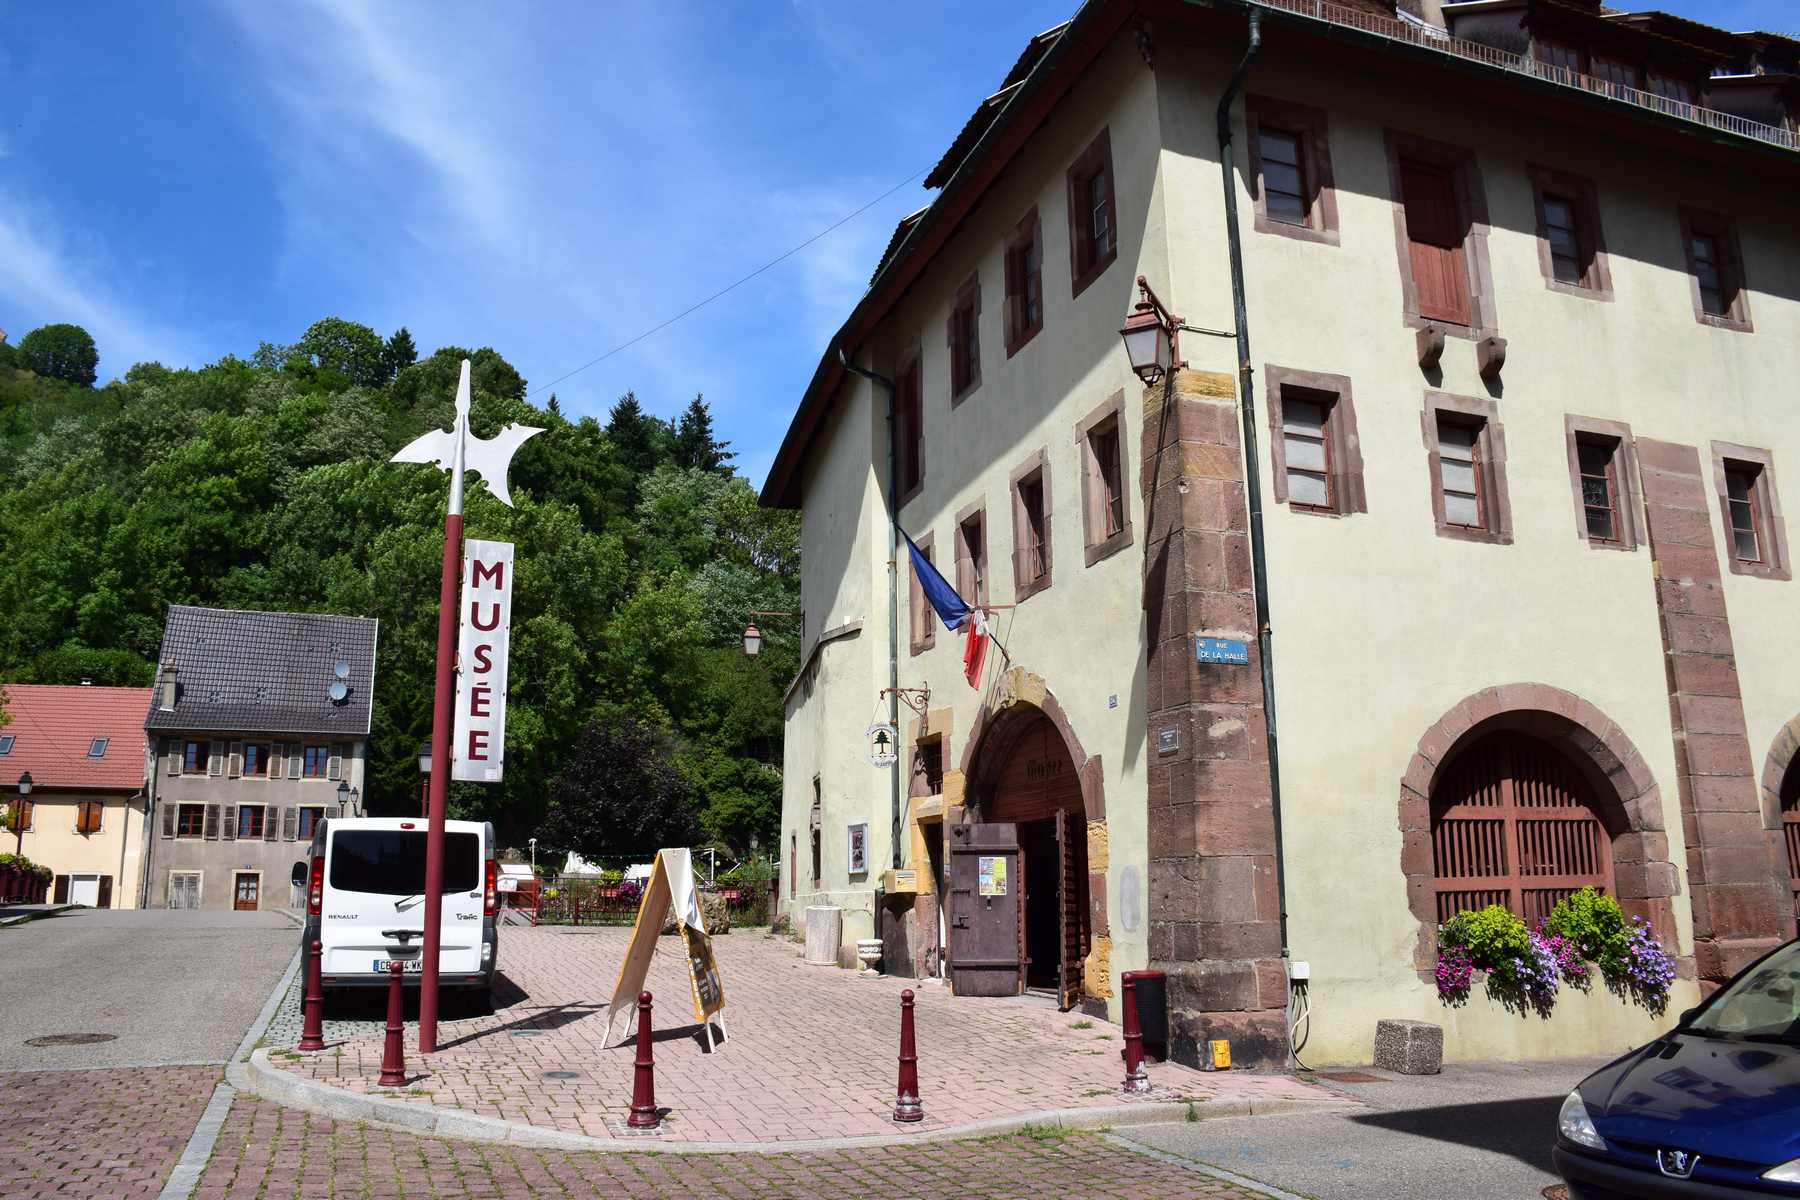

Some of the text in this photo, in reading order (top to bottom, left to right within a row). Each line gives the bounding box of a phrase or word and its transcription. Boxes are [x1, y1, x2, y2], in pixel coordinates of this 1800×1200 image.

[468, 559, 504, 760] MUSÉE
[1200, 650, 1211, 658] DE
[1212, 651, 1222, 659] LA
